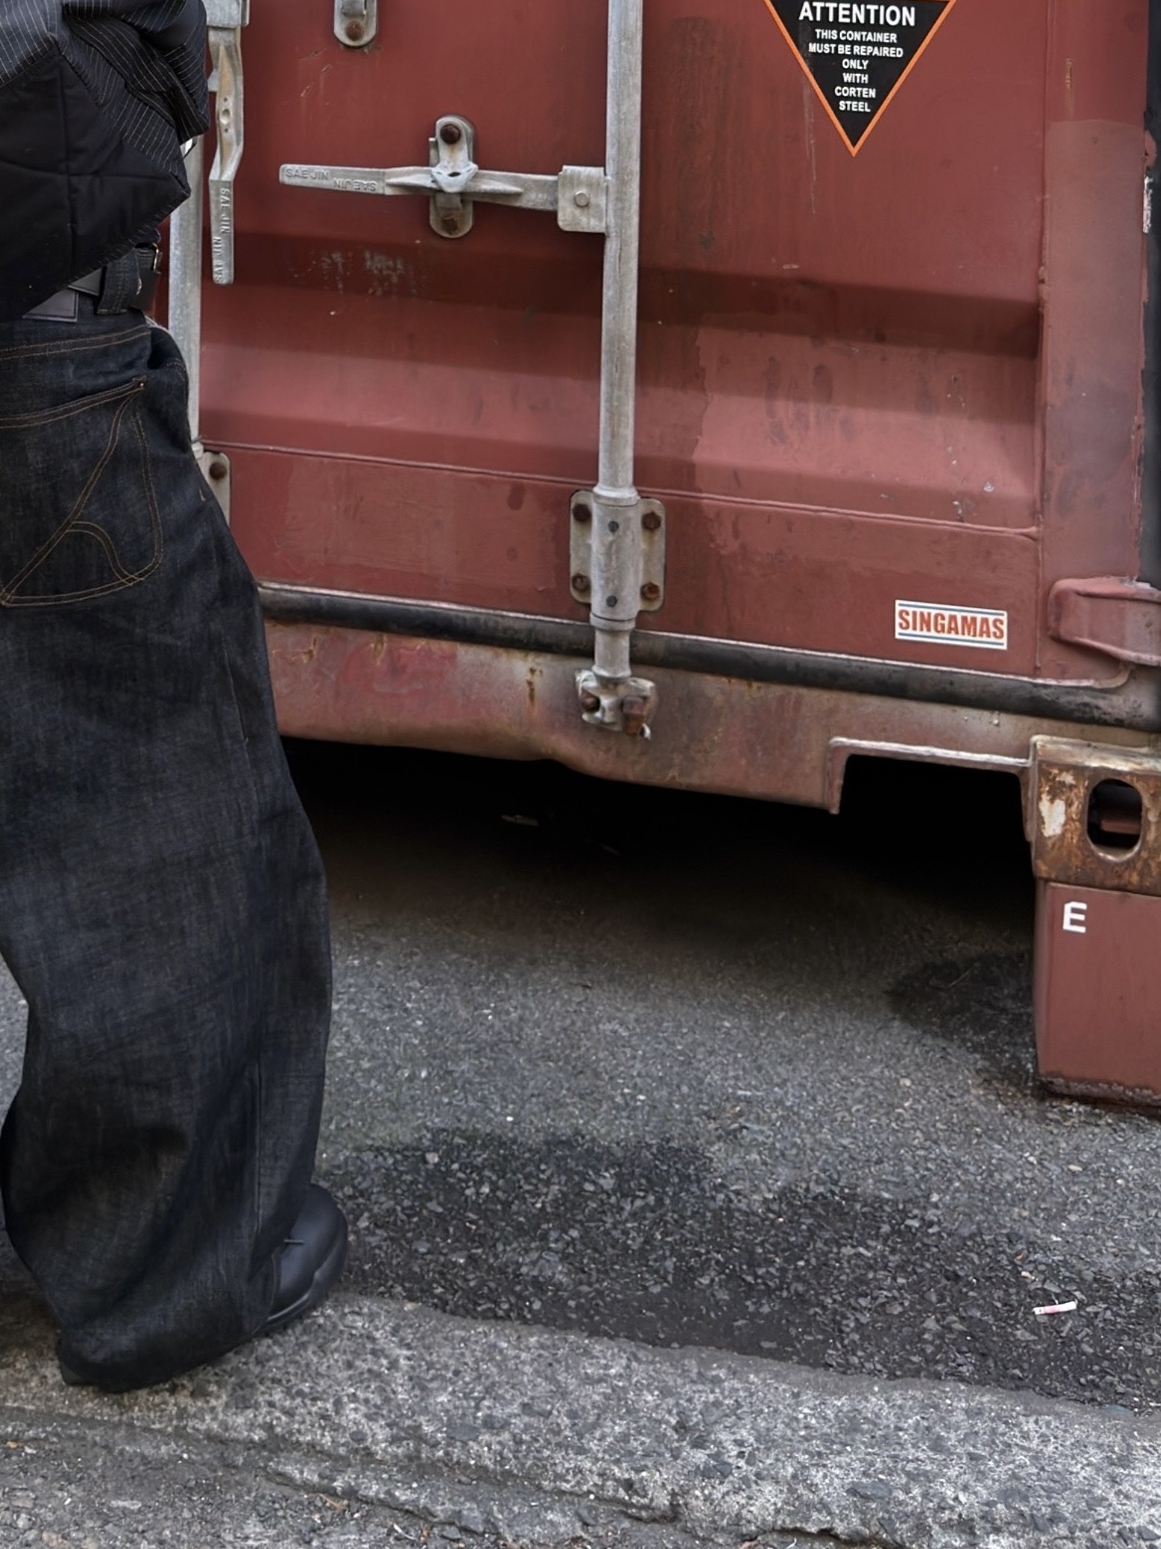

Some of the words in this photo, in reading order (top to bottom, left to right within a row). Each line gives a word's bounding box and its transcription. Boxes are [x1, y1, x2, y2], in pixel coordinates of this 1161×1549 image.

[798, 1, 916, 27] ATTENTION
[815, 29, 838, 40] THIS
[839, 30, 897, 44] CONTAINER
[808, 42, 837, 54] MUST
[837, 44, 852, 55] BE
[853, 45, 904, 58] REPAIRED
[842, 58, 869, 70] ONLY
[842, 72, 869, 84] WITH
[834, 86, 877, 98] CORTEN
[839, 100, 871, 112] STEEL
[898, 608, 1005, 640] SINGAMAS
[1062, 901, 1087, 934] E
